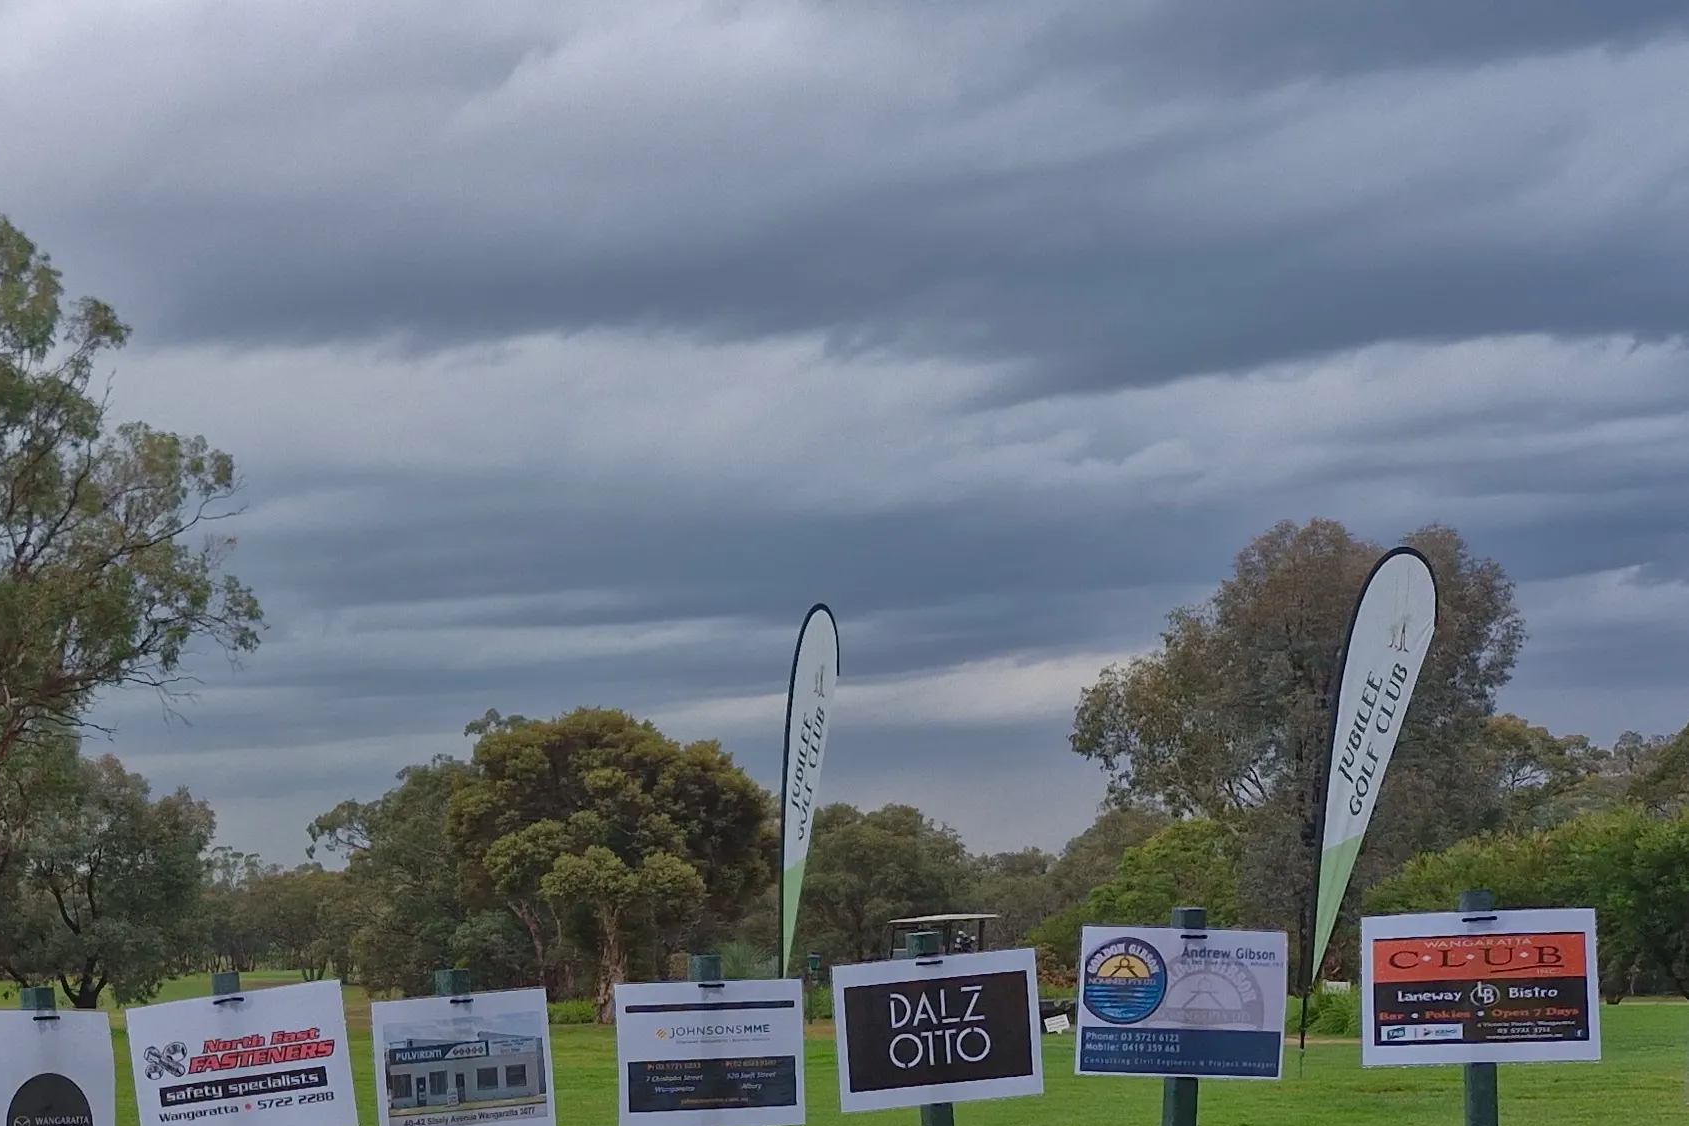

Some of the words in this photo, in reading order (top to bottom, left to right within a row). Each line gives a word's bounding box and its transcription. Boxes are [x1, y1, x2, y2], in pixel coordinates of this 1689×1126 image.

[809, 706, 825, 768] CLUB
[1337, 670, 1384, 784] JUBILEE
[1349, 742, 1380, 817] GOLF
[1375, 662, 1409, 734] CLUB
[1181, 946, 1231, 959] Andrew
[1236, 947, 1276, 961] Gibson
[1424, 937, 1533, 950] WANGARATTA
[1397, 989, 1462, 1003] Laneway
[1508, 986, 1558, 999] Bistro
[889, 985, 985, 1029] DALZ
[1379, 1011, 1404, 1021] Bar
[1424, 1009, 1471, 1020] Pokies
[1491, 1008, 1529, 1019] Open
[1533, 1008, 1540, 1017] 7
[1545, 1007, 1580, 1017] Days
[203, 1035, 265, 1054] North
[271, 1027, 320, 1046] East
[669, 1024, 770, 1039] JOHNSONSMME
[1085, 1031, 1118, 1041] Phone:
[1121, 1033, 1133, 1041] 03
[1135, 1033, 1156, 1042] 5721
[1158, 1034, 1180, 1042] 6122
[188, 1039, 335, 1075] FASTENERS
[889, 1027, 991, 1069] OTTO
[1085, 1041, 1120, 1051] Mobile:
[1122, 1043, 1144, 1052] 0419
[1084, 1056, 1131, 1066] Consulting
[1134, 1056, 1154, 1065] Civil
[1156, 1057, 1196, 1067] Engineers
[1208, 1059, 1239, 1068] Project
[166, 1083, 223, 1102] safety
[228, 1072, 319, 1095] specialists
[159, 1105, 239, 1122] Wangaratta
[257, 1096, 294, 1110] 5722
[298, 1091, 334, 1105] 2288
[35, 1115, 90, 1125] WANGARATTA
